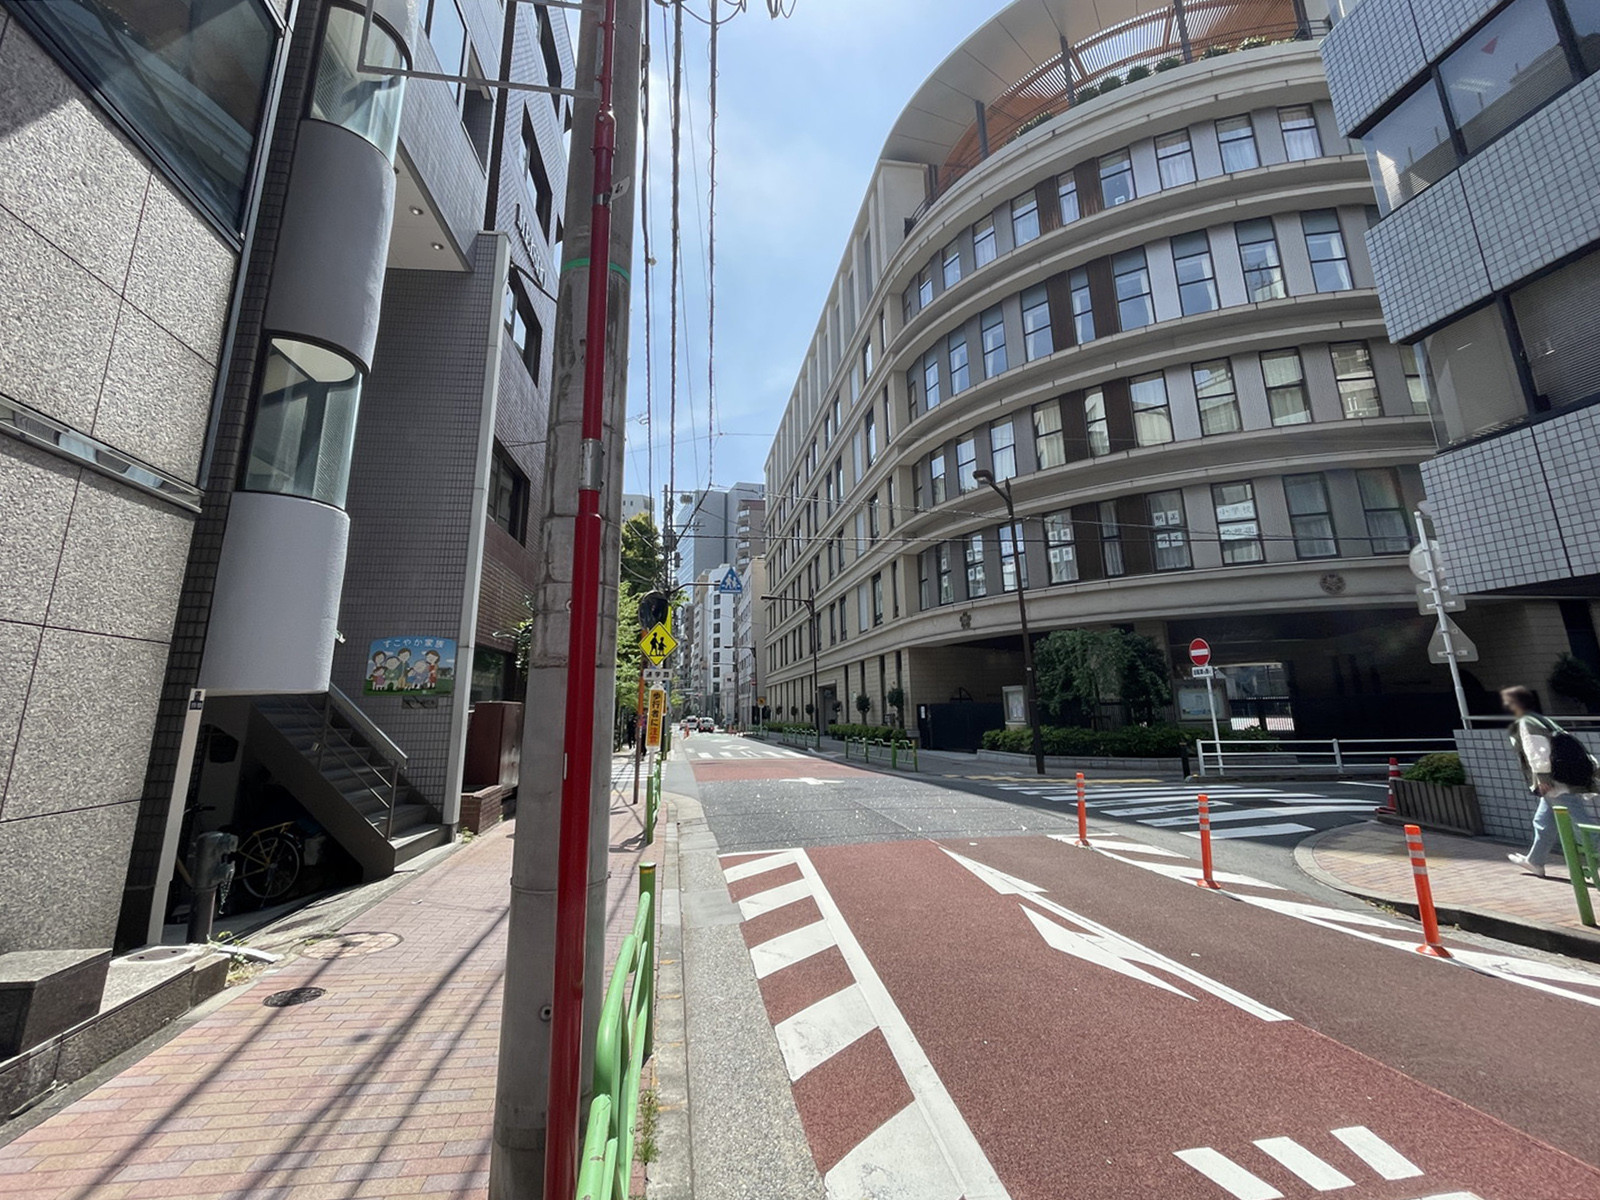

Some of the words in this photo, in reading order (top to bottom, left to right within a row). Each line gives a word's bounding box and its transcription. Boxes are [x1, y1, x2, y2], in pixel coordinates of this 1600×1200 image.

[383, 639, 445, 648] すこやか家族
[650, 692, 660, 744] 歩行者に注意
